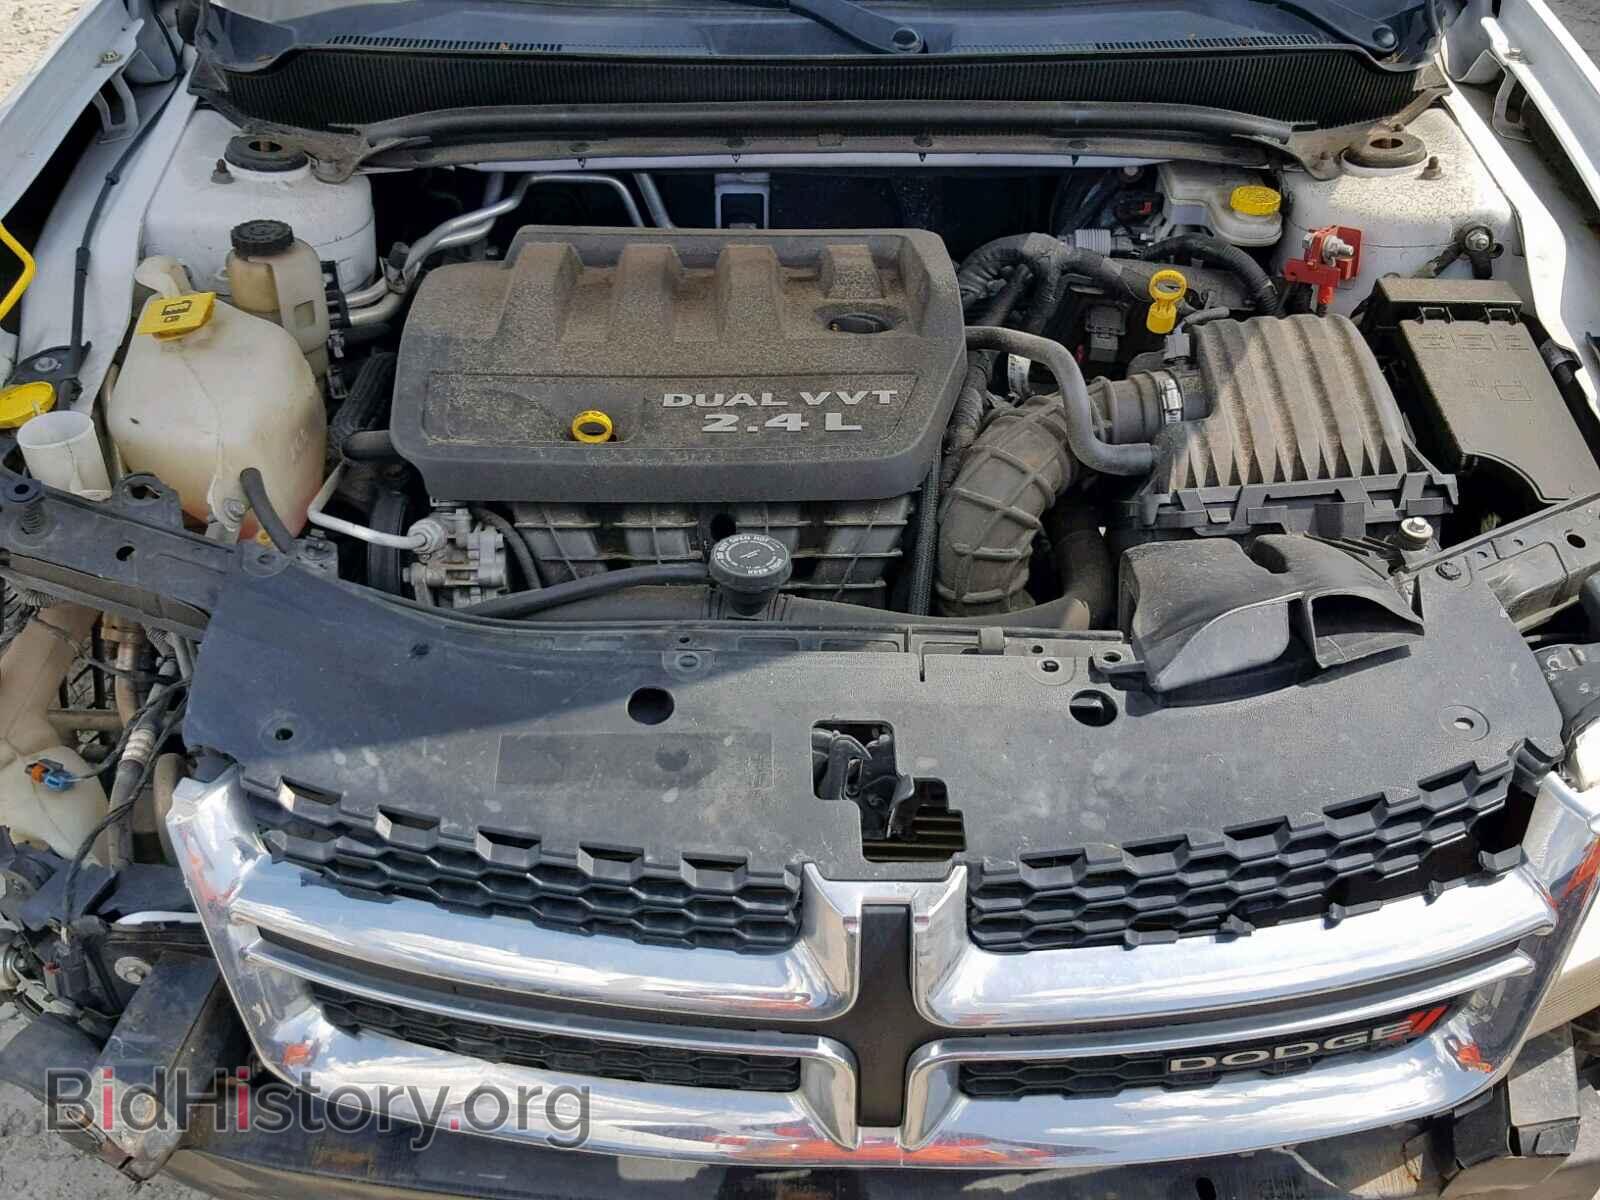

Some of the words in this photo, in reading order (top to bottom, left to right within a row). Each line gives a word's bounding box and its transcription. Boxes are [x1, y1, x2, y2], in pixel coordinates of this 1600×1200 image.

[663, 392, 788, 407] DUAL
[800, 390, 897, 405] VVT
[1169, 1019, 1414, 1073] DODGE
